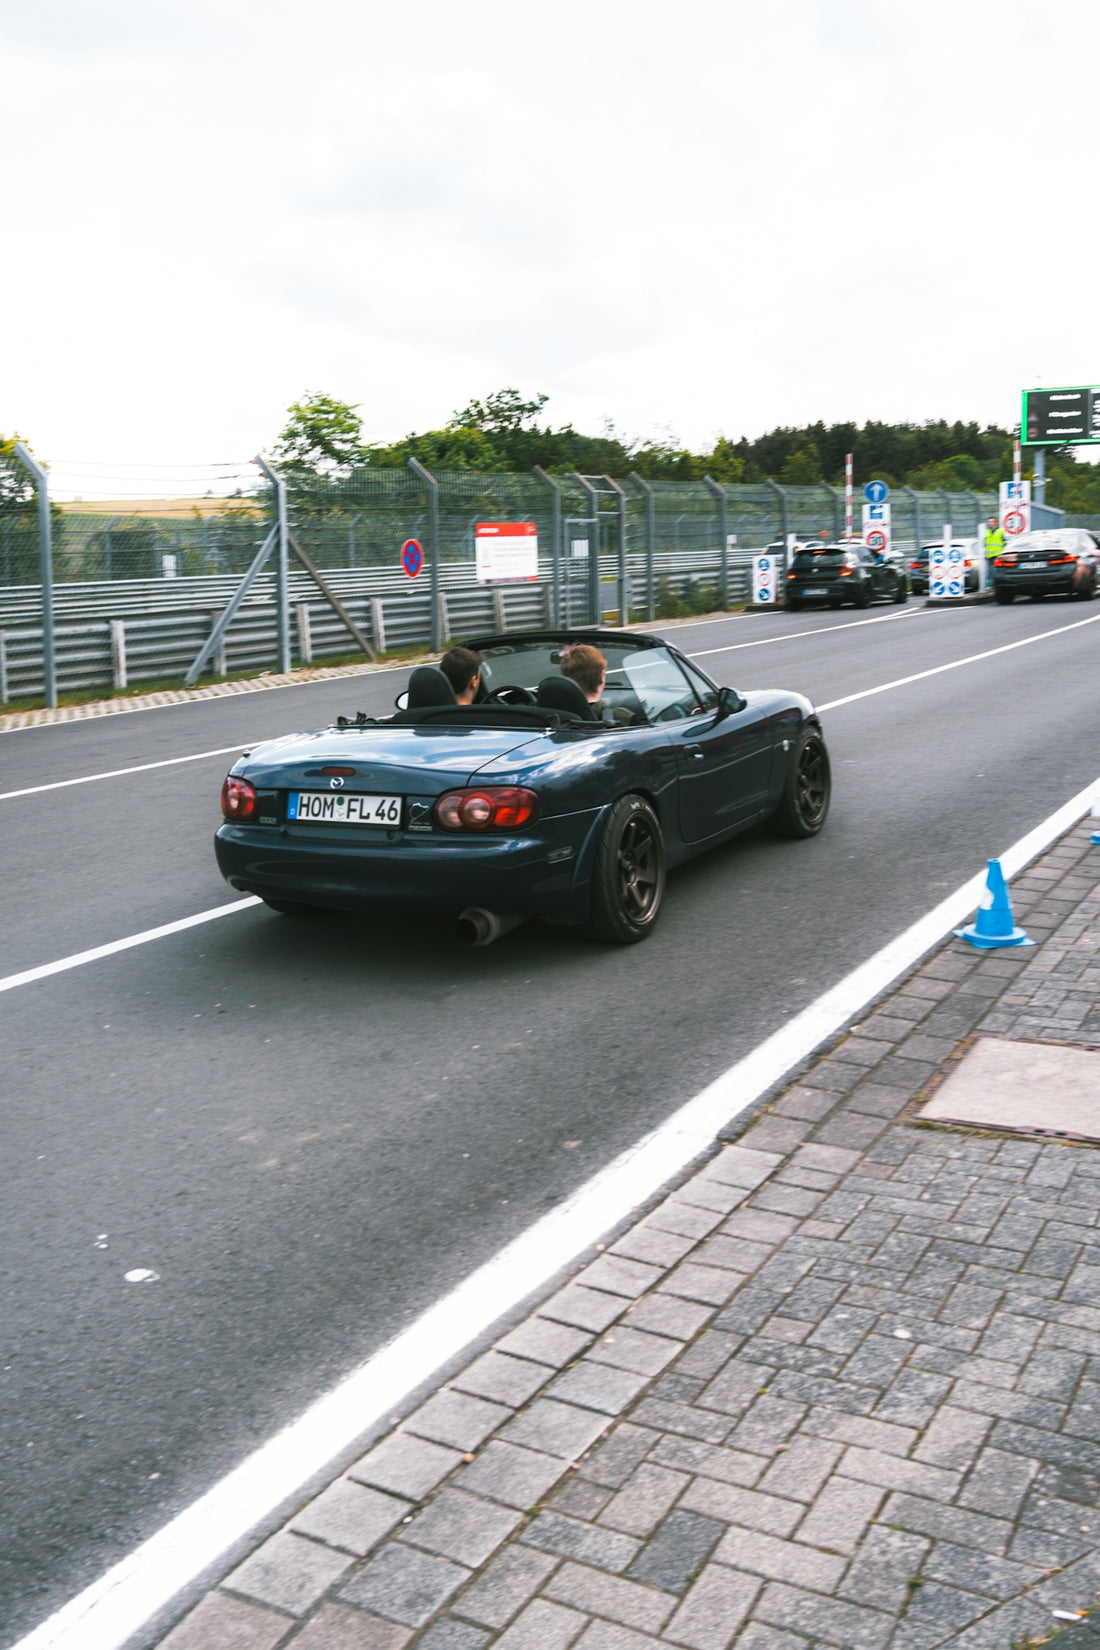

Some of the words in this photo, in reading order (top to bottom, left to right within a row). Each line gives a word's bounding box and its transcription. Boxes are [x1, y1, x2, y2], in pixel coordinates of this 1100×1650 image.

[298, 796, 335, 818] HOM
[346, 798, 370, 820] FL
[375, 799, 398, 821] 46
